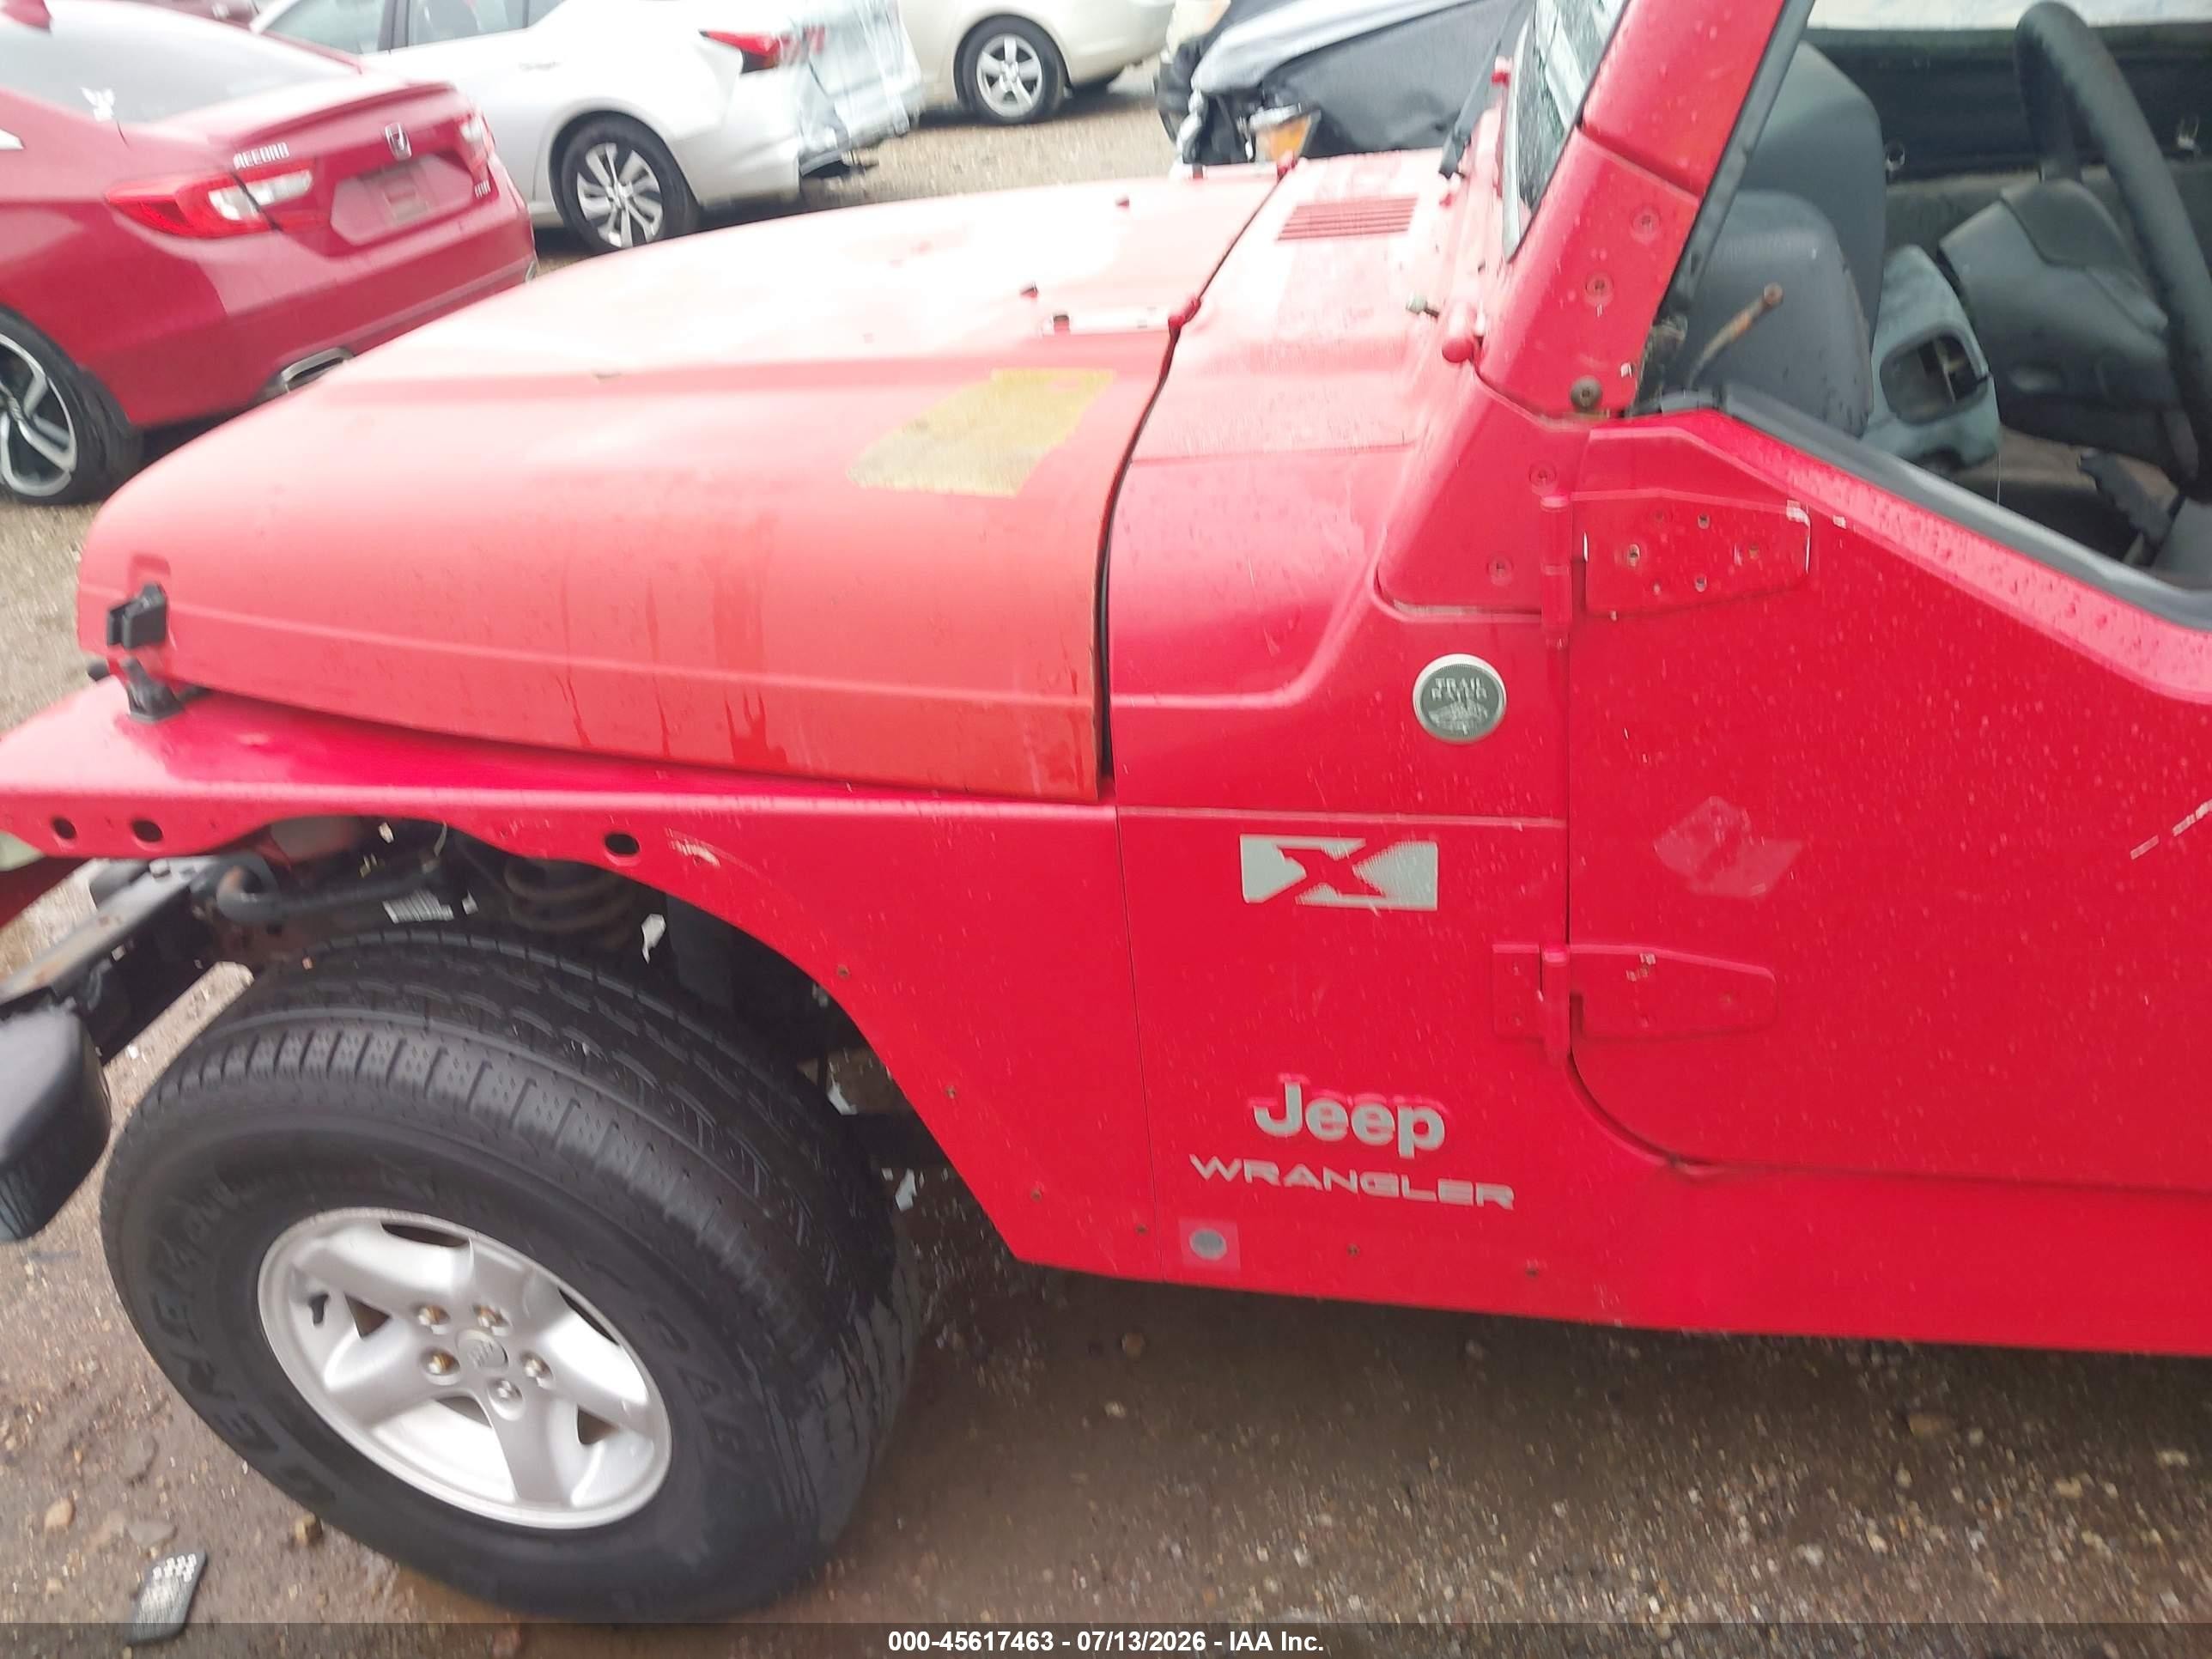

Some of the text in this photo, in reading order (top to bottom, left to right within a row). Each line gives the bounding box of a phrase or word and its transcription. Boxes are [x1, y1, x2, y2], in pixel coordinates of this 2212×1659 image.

[233, 141, 290, 170] ACCORD
[1253, 1080, 1446, 1159] Jeep
[1188, 1154, 1516, 1211] WRANGLER
